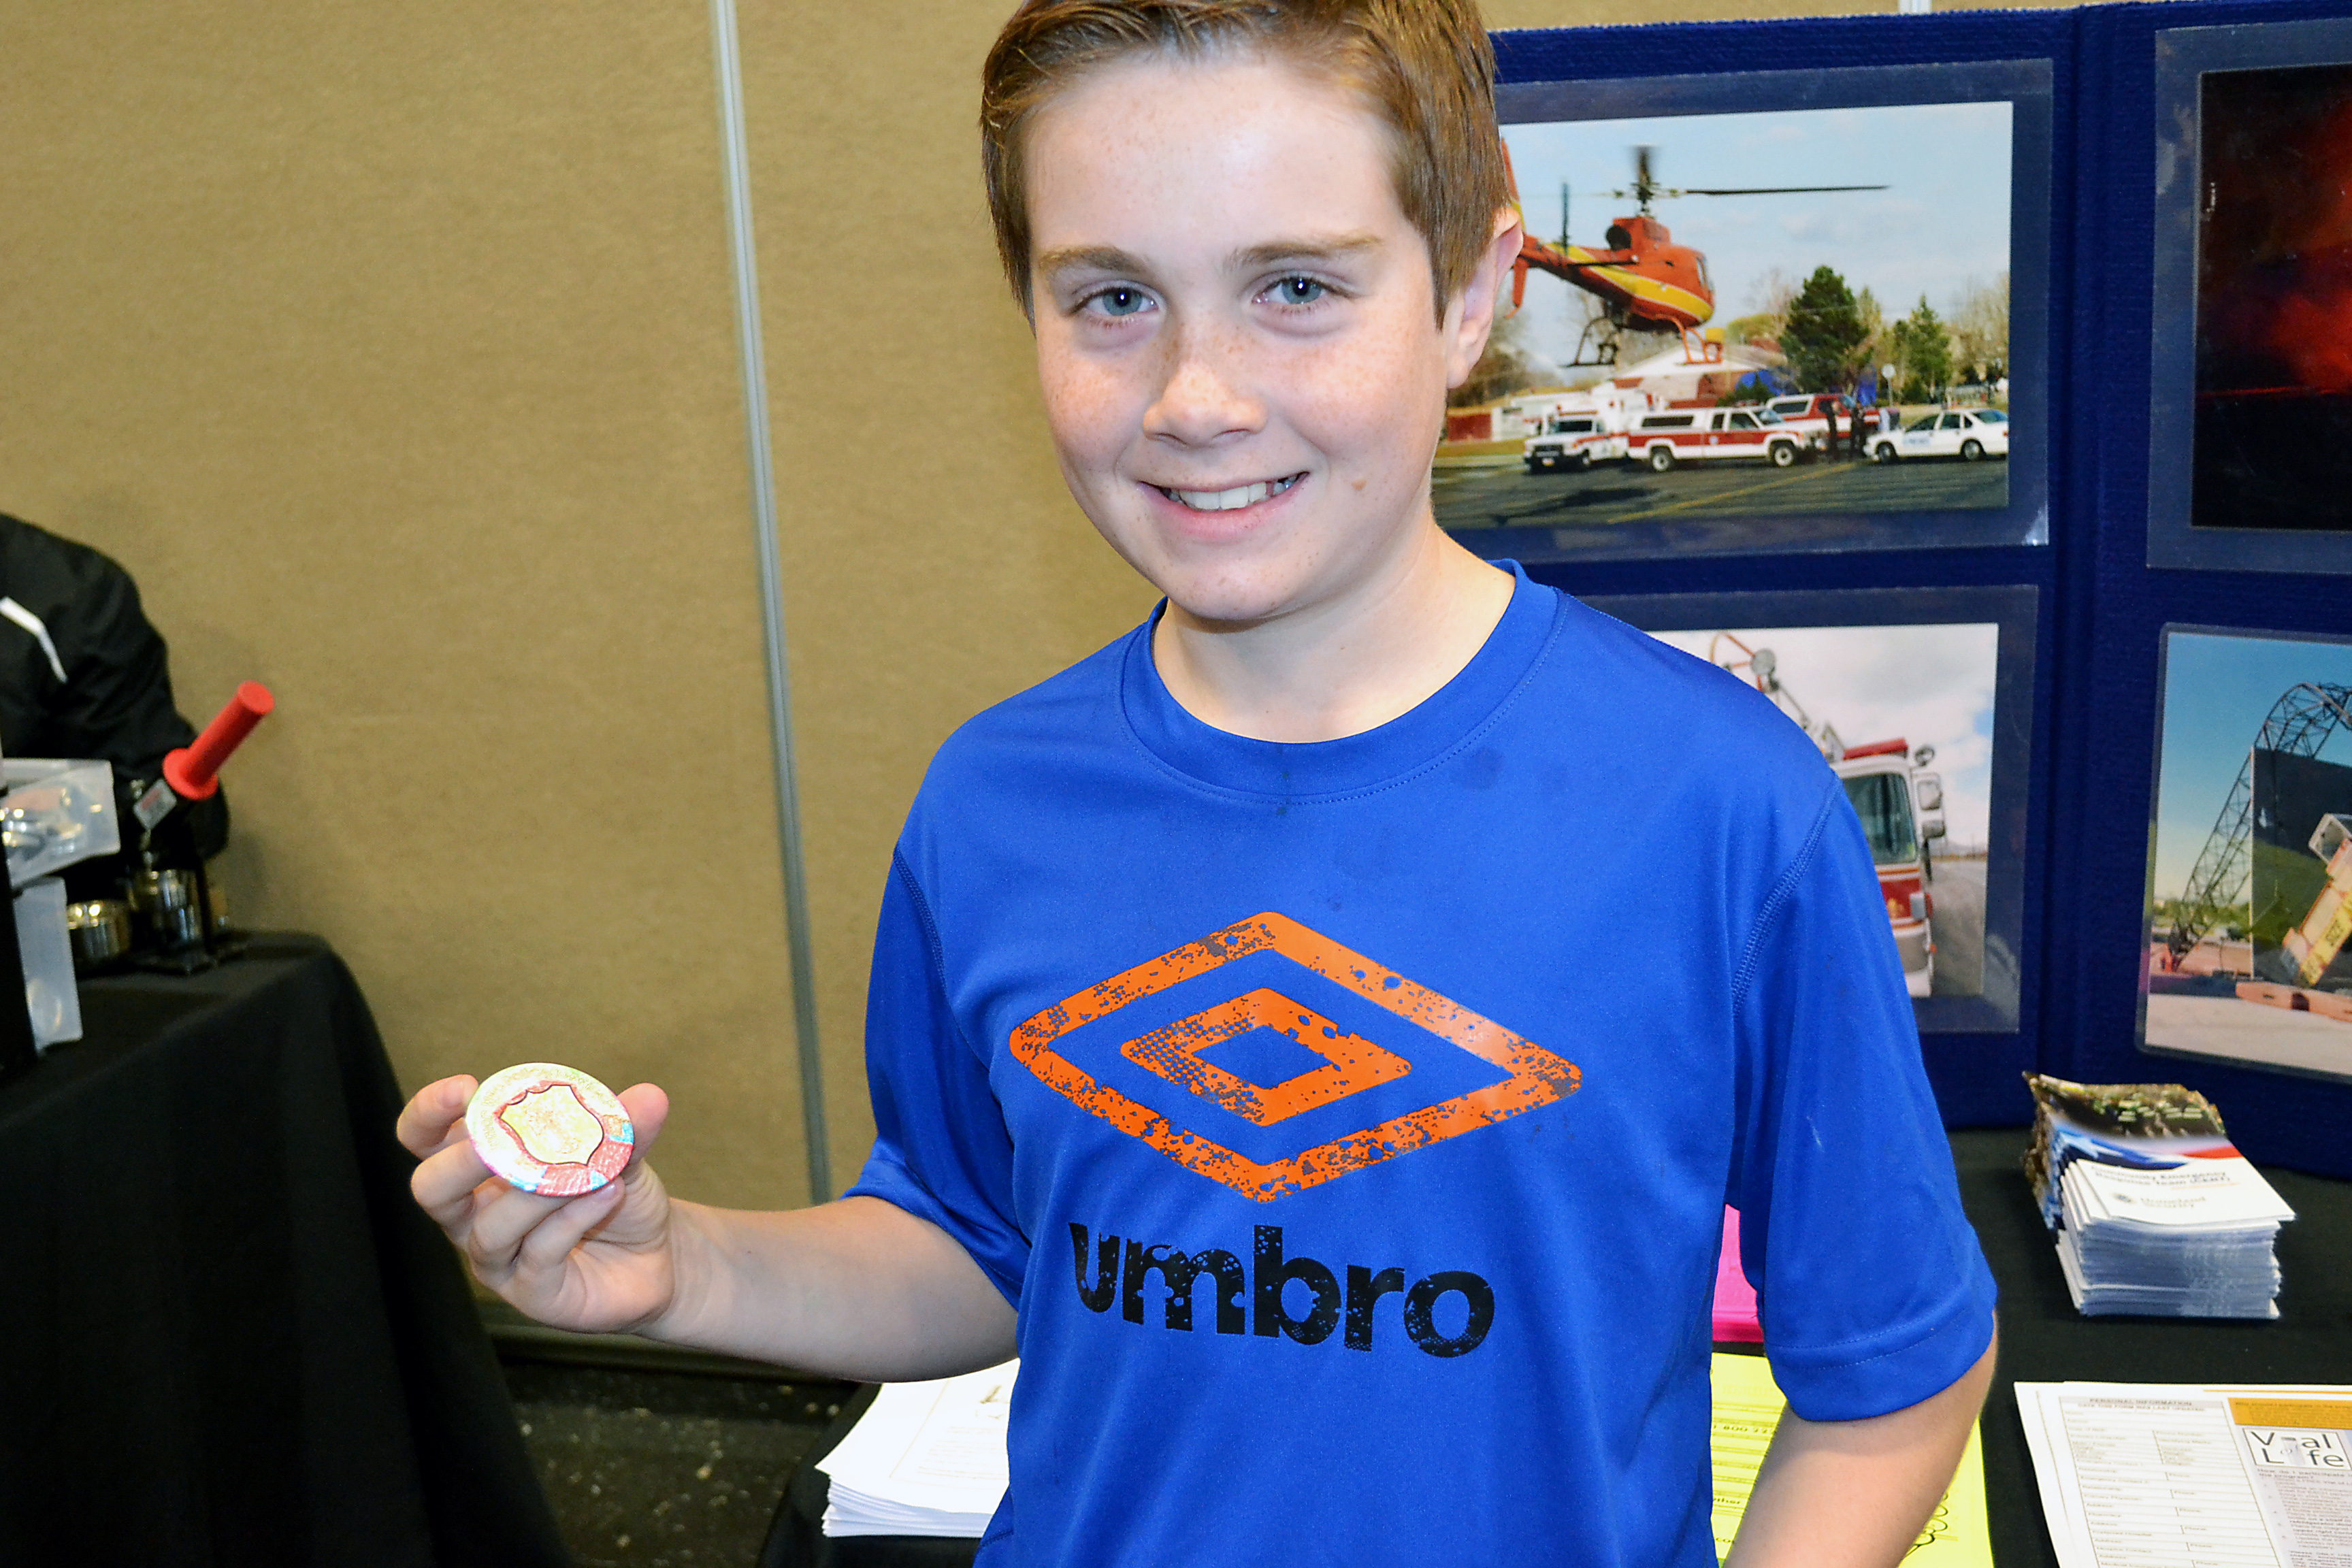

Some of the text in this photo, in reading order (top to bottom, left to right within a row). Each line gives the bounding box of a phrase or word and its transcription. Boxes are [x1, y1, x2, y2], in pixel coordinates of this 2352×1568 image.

[1068, 1222, 1494, 1358] umbro
[2251, 1431, 2332, 1449] Val
[2261, 1448, 2345, 1467] Lfe
